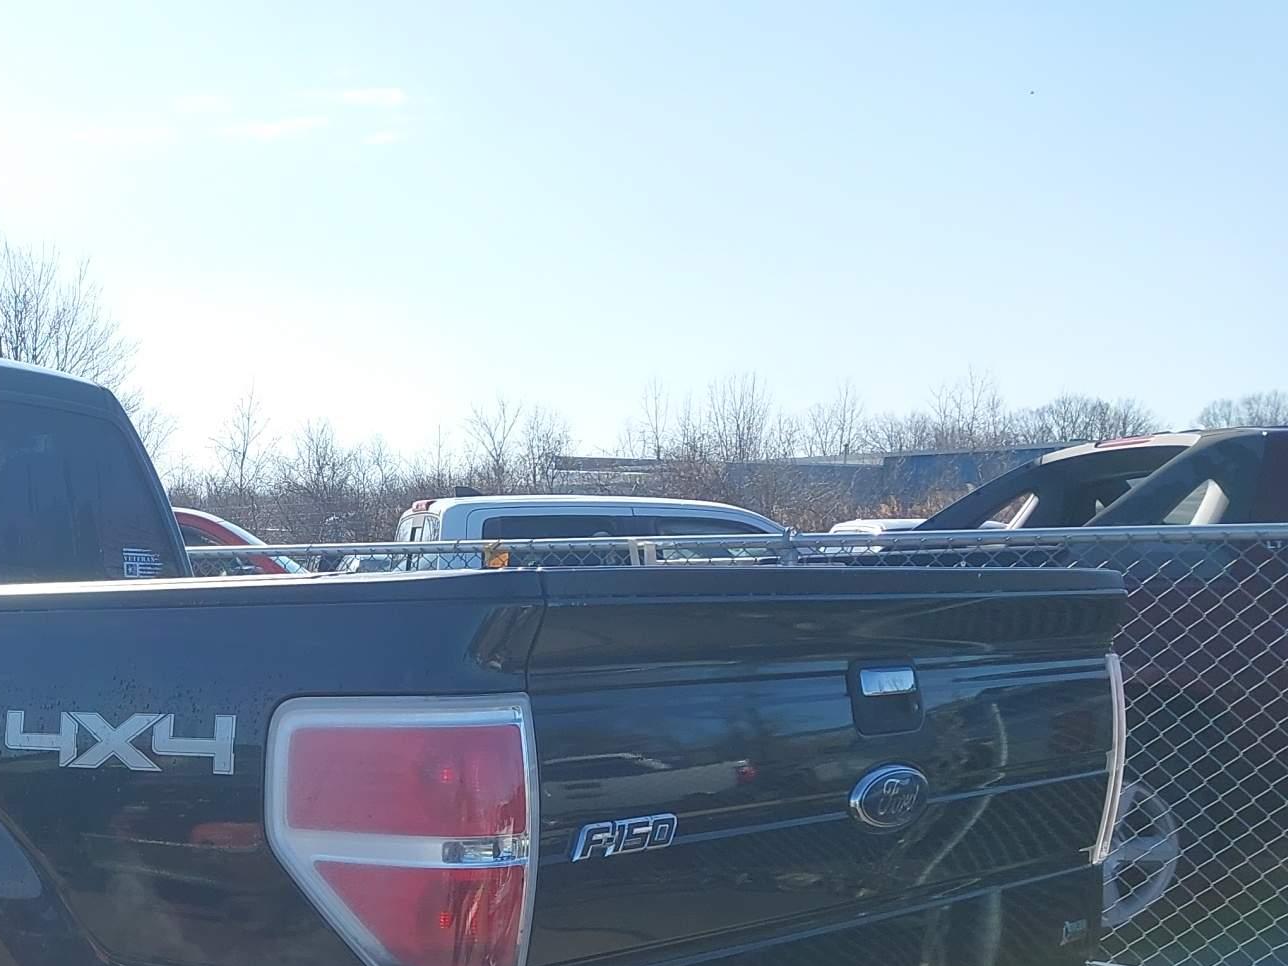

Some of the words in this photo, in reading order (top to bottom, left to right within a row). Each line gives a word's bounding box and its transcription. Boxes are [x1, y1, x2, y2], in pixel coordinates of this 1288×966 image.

[5, 710, 237, 775] 4X4
[878, 778, 920, 816] Ford
[572, 813, 678, 862] F-150
